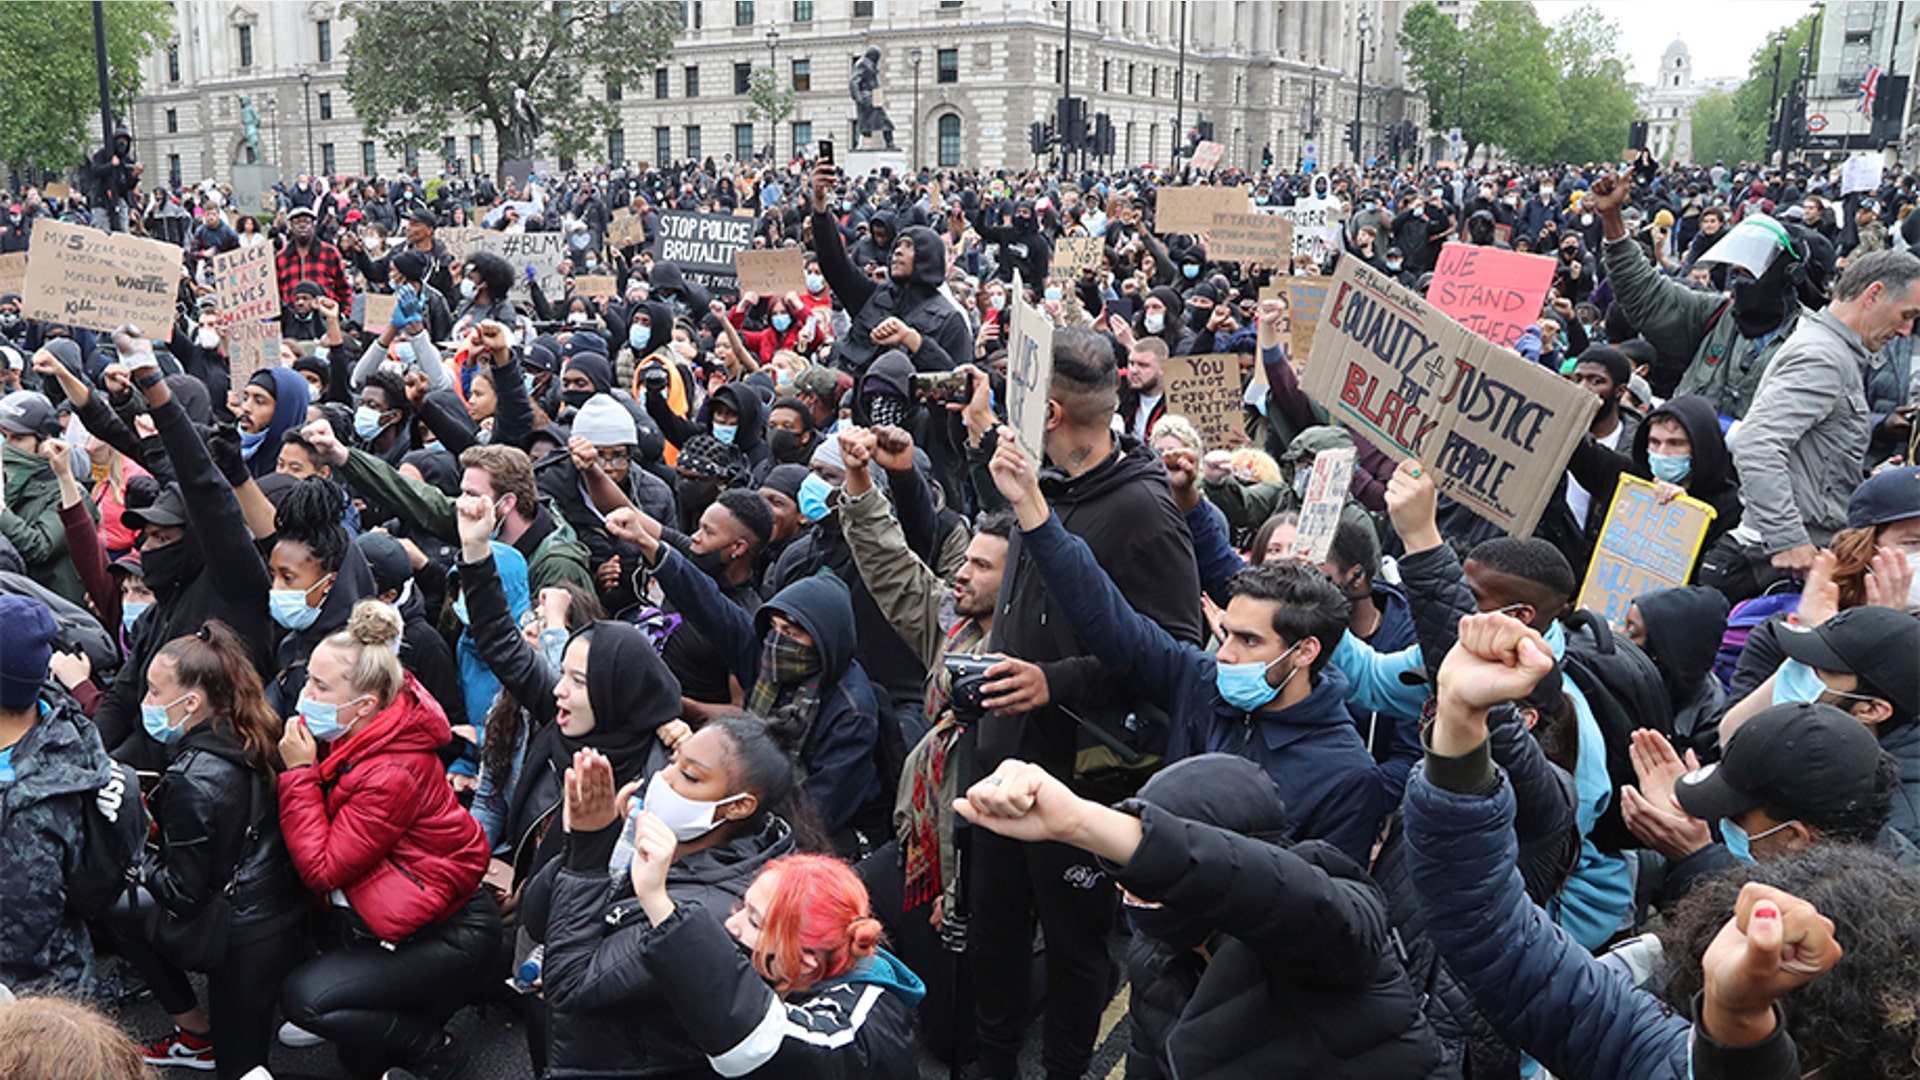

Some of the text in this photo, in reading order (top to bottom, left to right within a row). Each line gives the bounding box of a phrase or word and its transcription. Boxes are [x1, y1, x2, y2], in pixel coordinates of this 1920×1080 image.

[660, 215, 697, 240] STOP
[698, 218, 751, 244] POLICE
[43, 231, 68, 247] MY
[67, 234, 85, 251] 5
[85, 241, 116, 254] YEAR
[119, 248, 140, 259] OLD
[55, 250, 95, 264] ASKED
[502, 235, 560, 256] #BLM
[217, 245, 267, 273] BLACK
[1440, 250, 1479, 277] WE
[216, 263, 269, 291] TRANS
[60, 286, 80, 298] THE
[221, 283, 266, 310] LIVES
[1440, 281, 1525, 313] STAND
[1186, 358, 1224, 377] YOU
[1329, 281, 1439, 375] EQUALITY
[1439, 357, 1554, 453] JUSTICE
[1169, 387, 1241, 404] ENJOY THE
[1170, 376, 1224, 391] CANNOT
[1183, 401, 1241, 414] RHYTHM
[1201, 415, 1222, 424] BUT
[1340, 361, 1440, 459] BLACK
[1434, 429, 1516, 503] PEOPLE
[1627, 490, 1686, 546] THE
